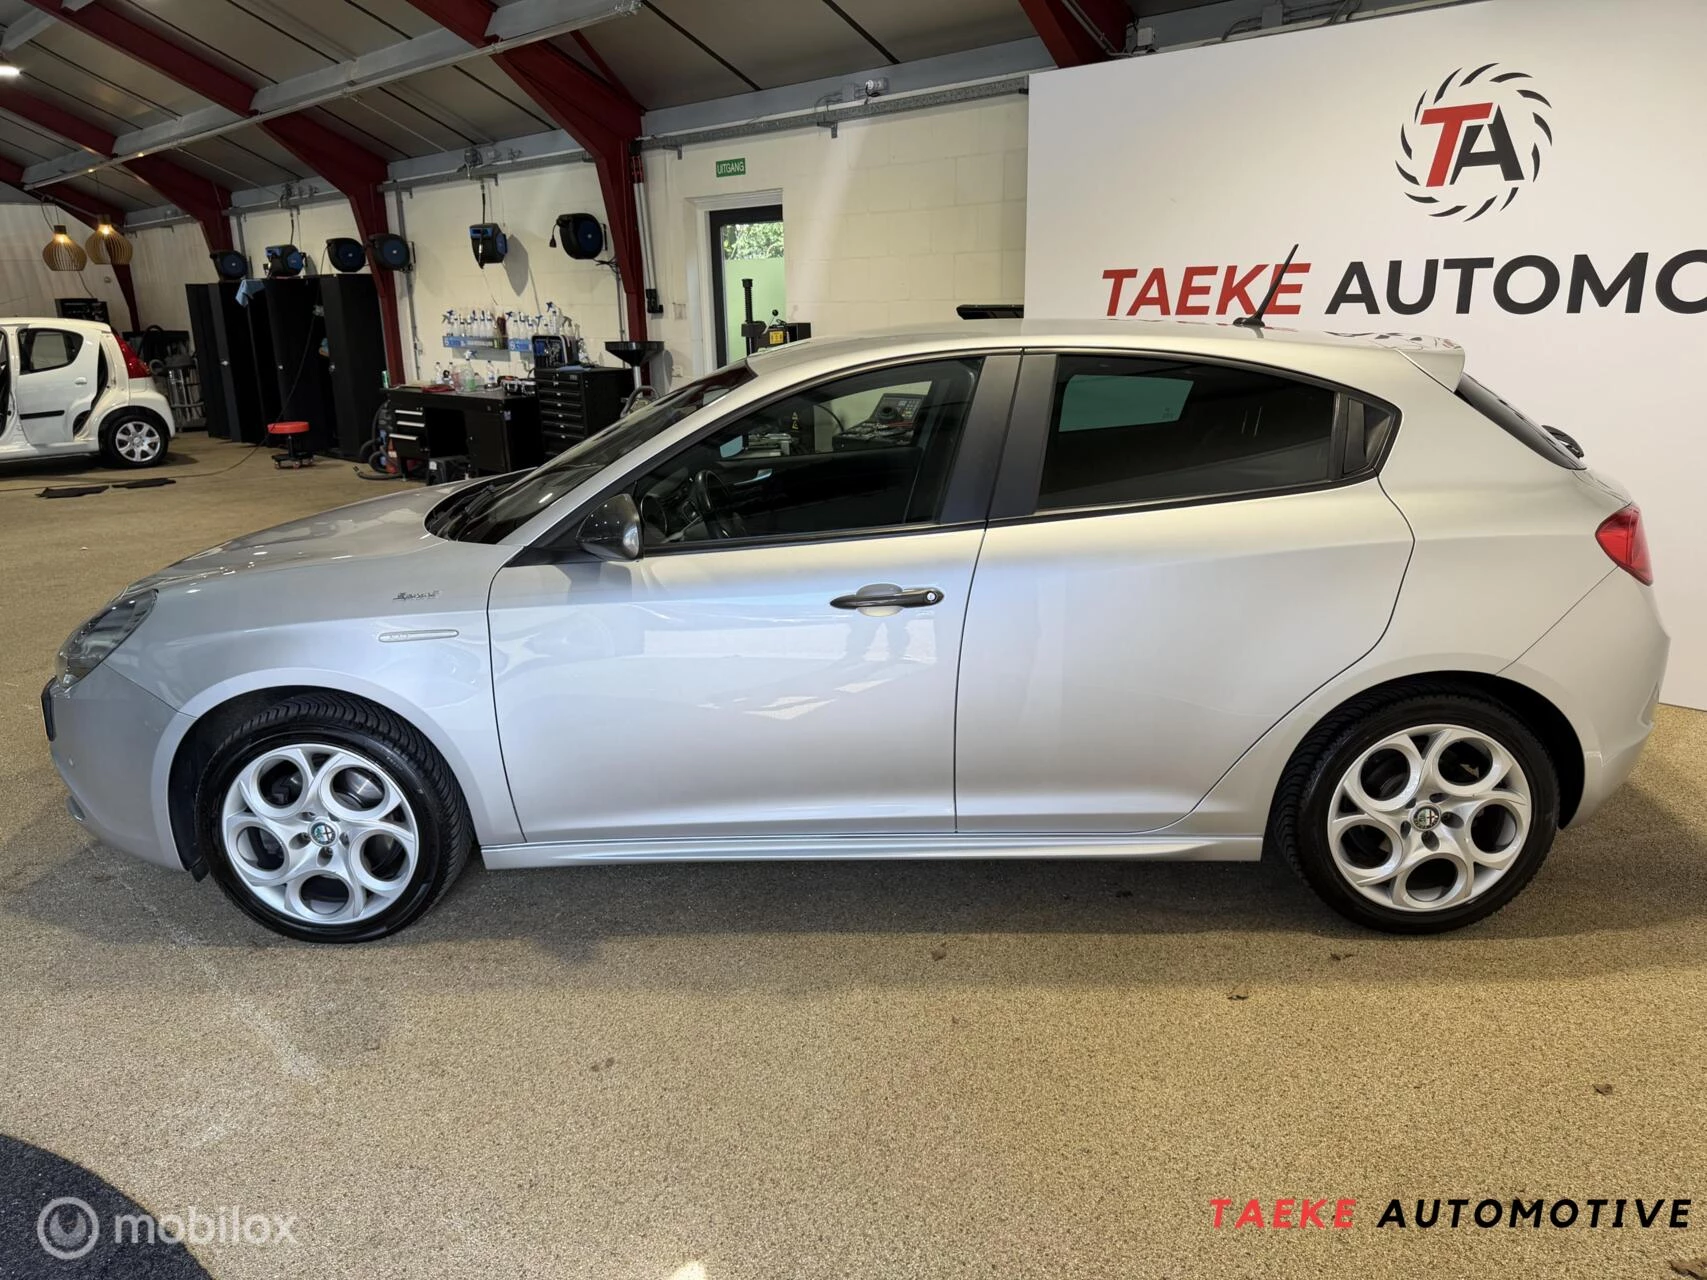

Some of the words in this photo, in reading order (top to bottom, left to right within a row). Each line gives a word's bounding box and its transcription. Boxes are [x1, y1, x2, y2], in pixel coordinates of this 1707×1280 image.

[717, 161, 745, 174] UITGANG
[1420, 102, 1525, 187] TA
[1102, 262, 1311, 316] TAEKE
